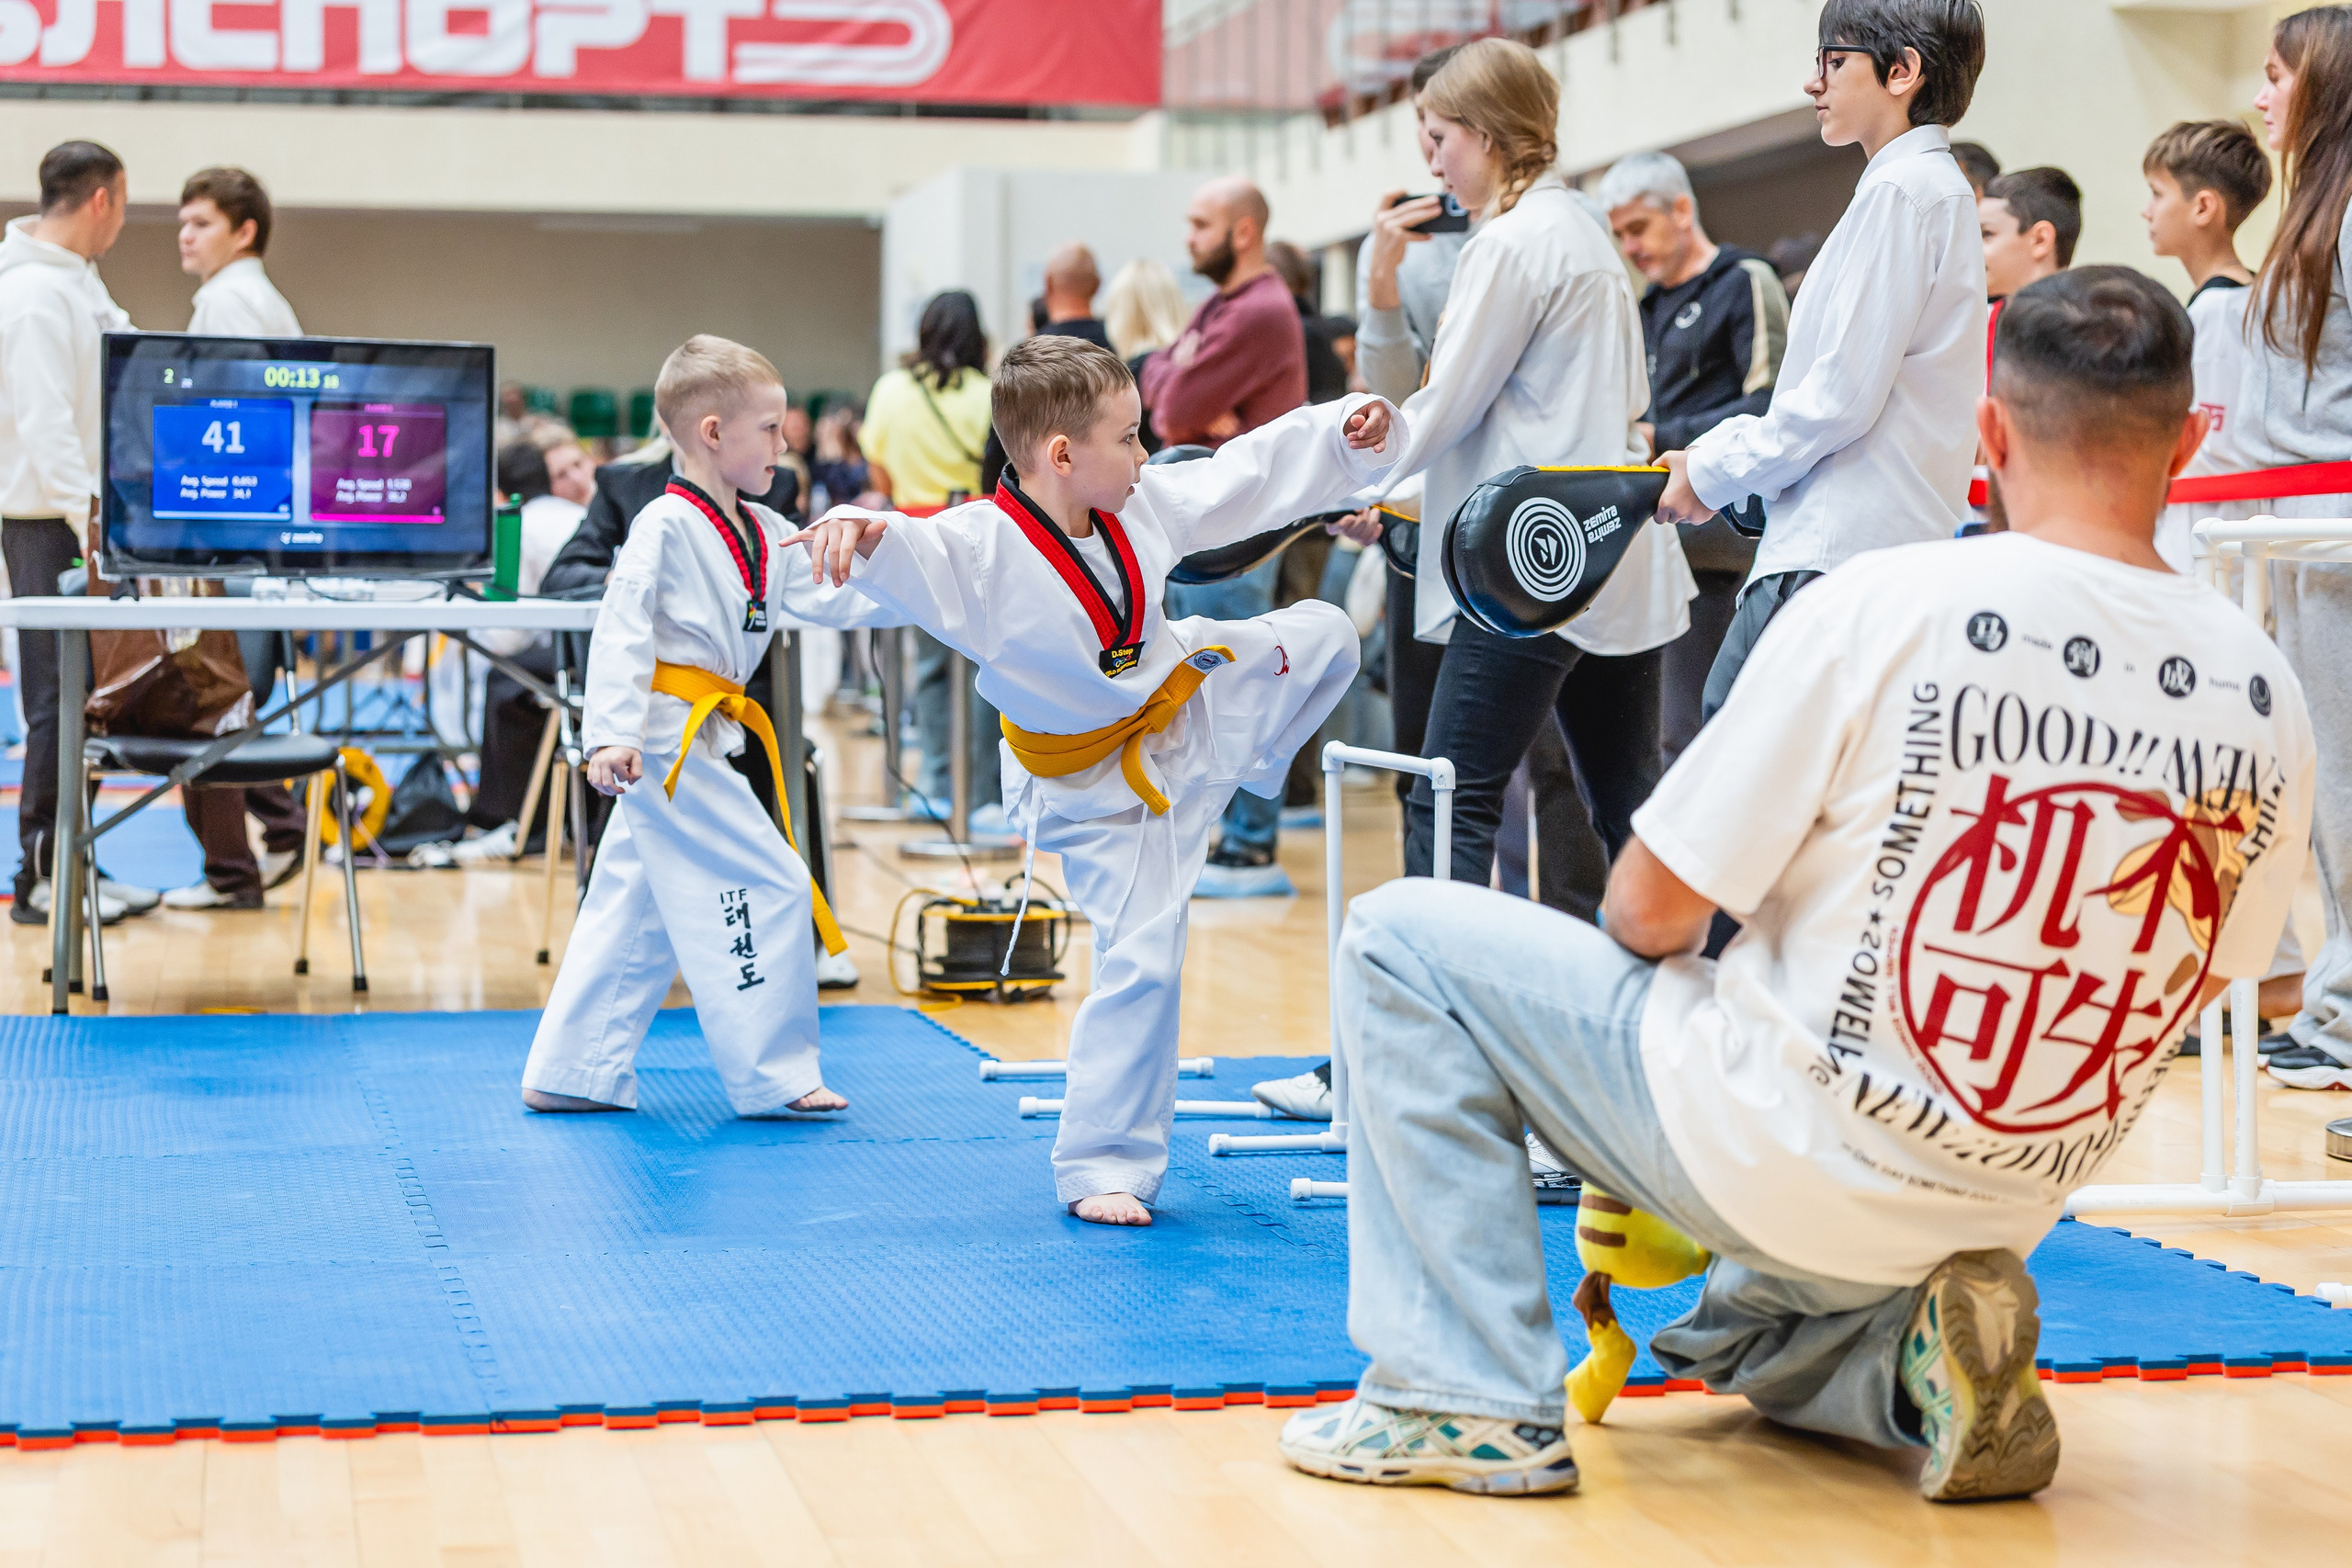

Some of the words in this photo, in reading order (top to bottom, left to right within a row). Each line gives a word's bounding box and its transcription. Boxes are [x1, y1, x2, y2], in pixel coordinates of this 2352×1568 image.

[0, 0, 764, 80] ЛСПОРТ
[164, 368, 175, 384] 2
[265, 367, 321, 389] 00:13
[201, 421, 245, 454] 41
[357, 424, 399, 457] 17
[1950, 682, 2160, 778] GOOD!!
[1871, 681, 1941, 901] SOMETHING
[720, 888, 747, 904] ITF
